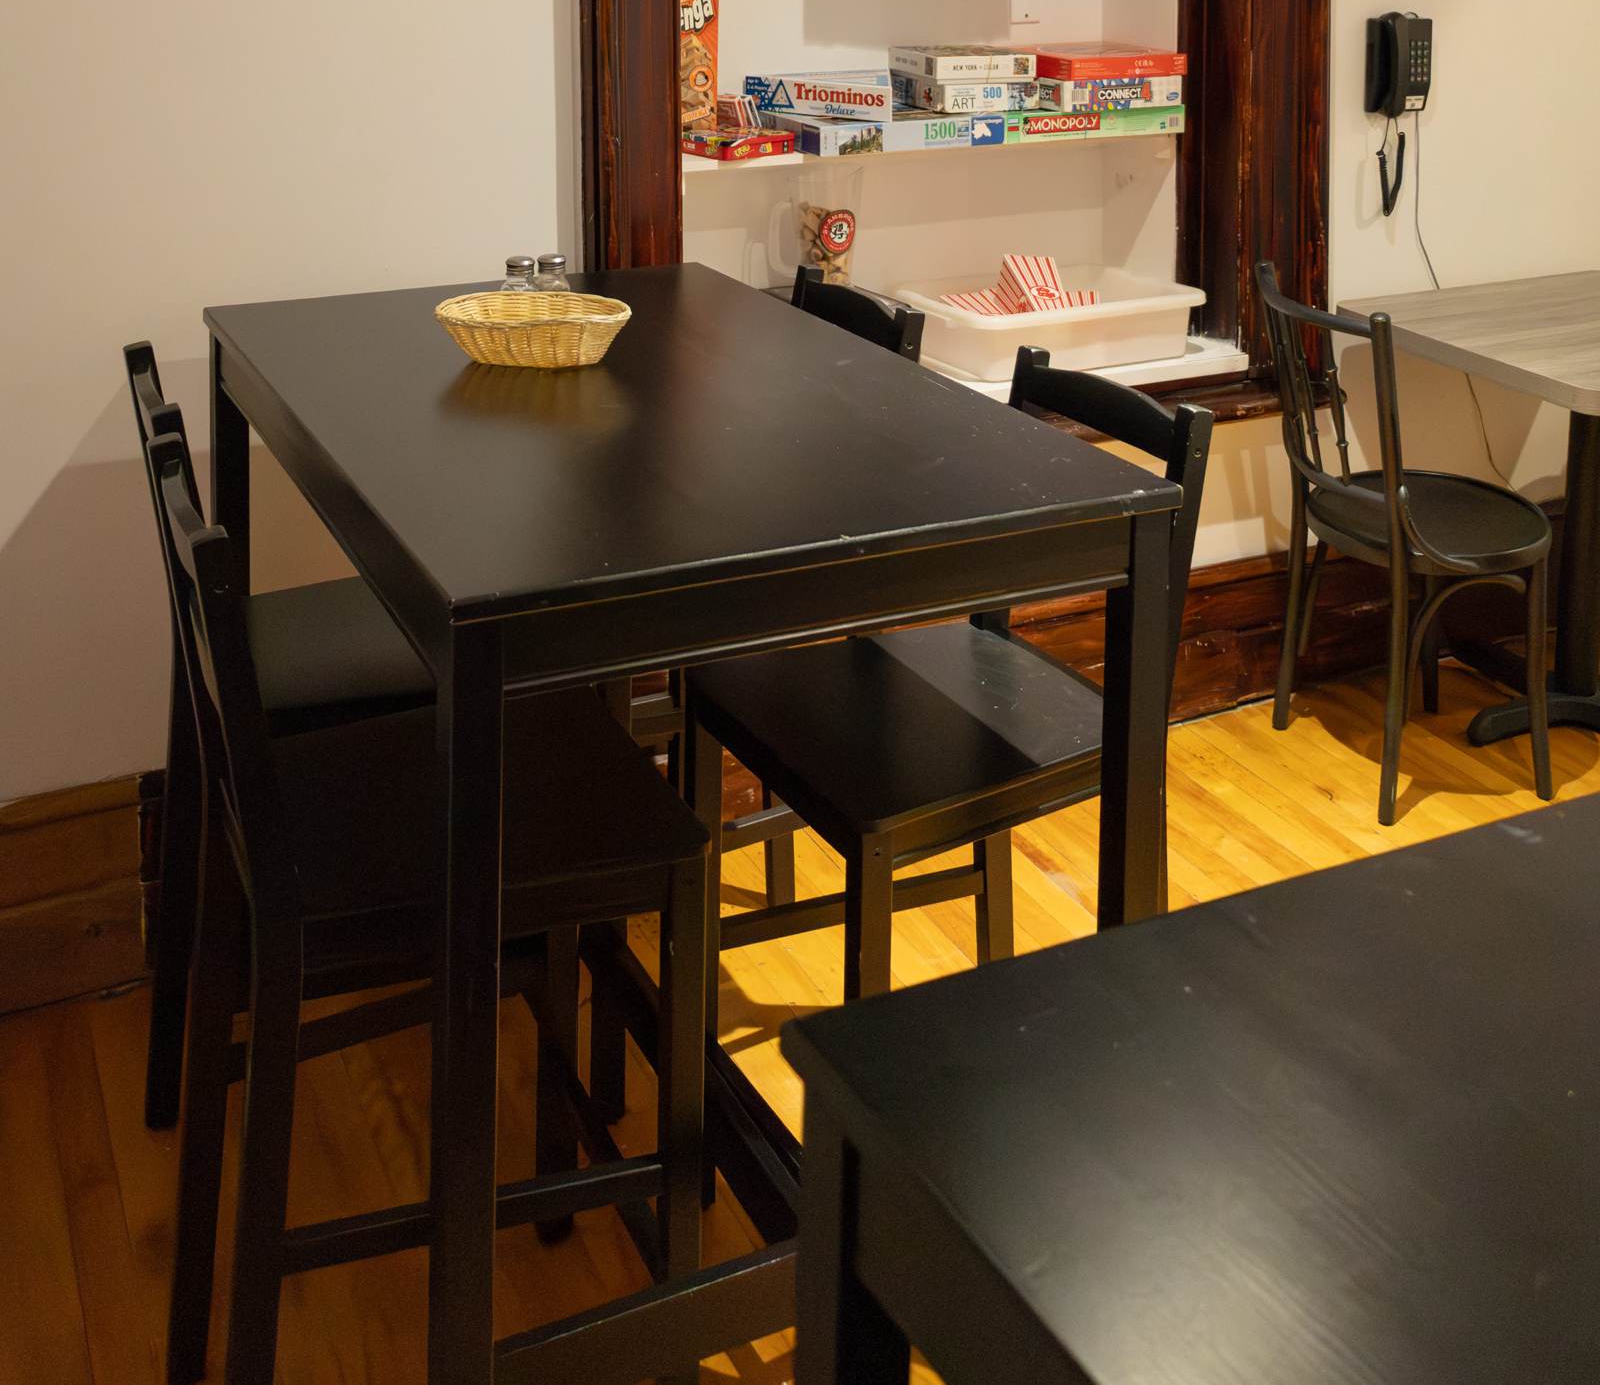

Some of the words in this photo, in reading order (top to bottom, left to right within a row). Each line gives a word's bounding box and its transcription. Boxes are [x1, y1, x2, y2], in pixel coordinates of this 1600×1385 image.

[793, 82, 885, 108] Triominos
[983, 86, 1002, 99] 500
[1098, 87, 1142, 101] CONNECT
[1140, 81, 1152, 102] 4
[824, 104, 856, 116] Deluxe
[951, 97, 976, 110] ART
[924, 121, 957, 140] 1500
[1030, 116, 1099, 133] MONOPOLY
